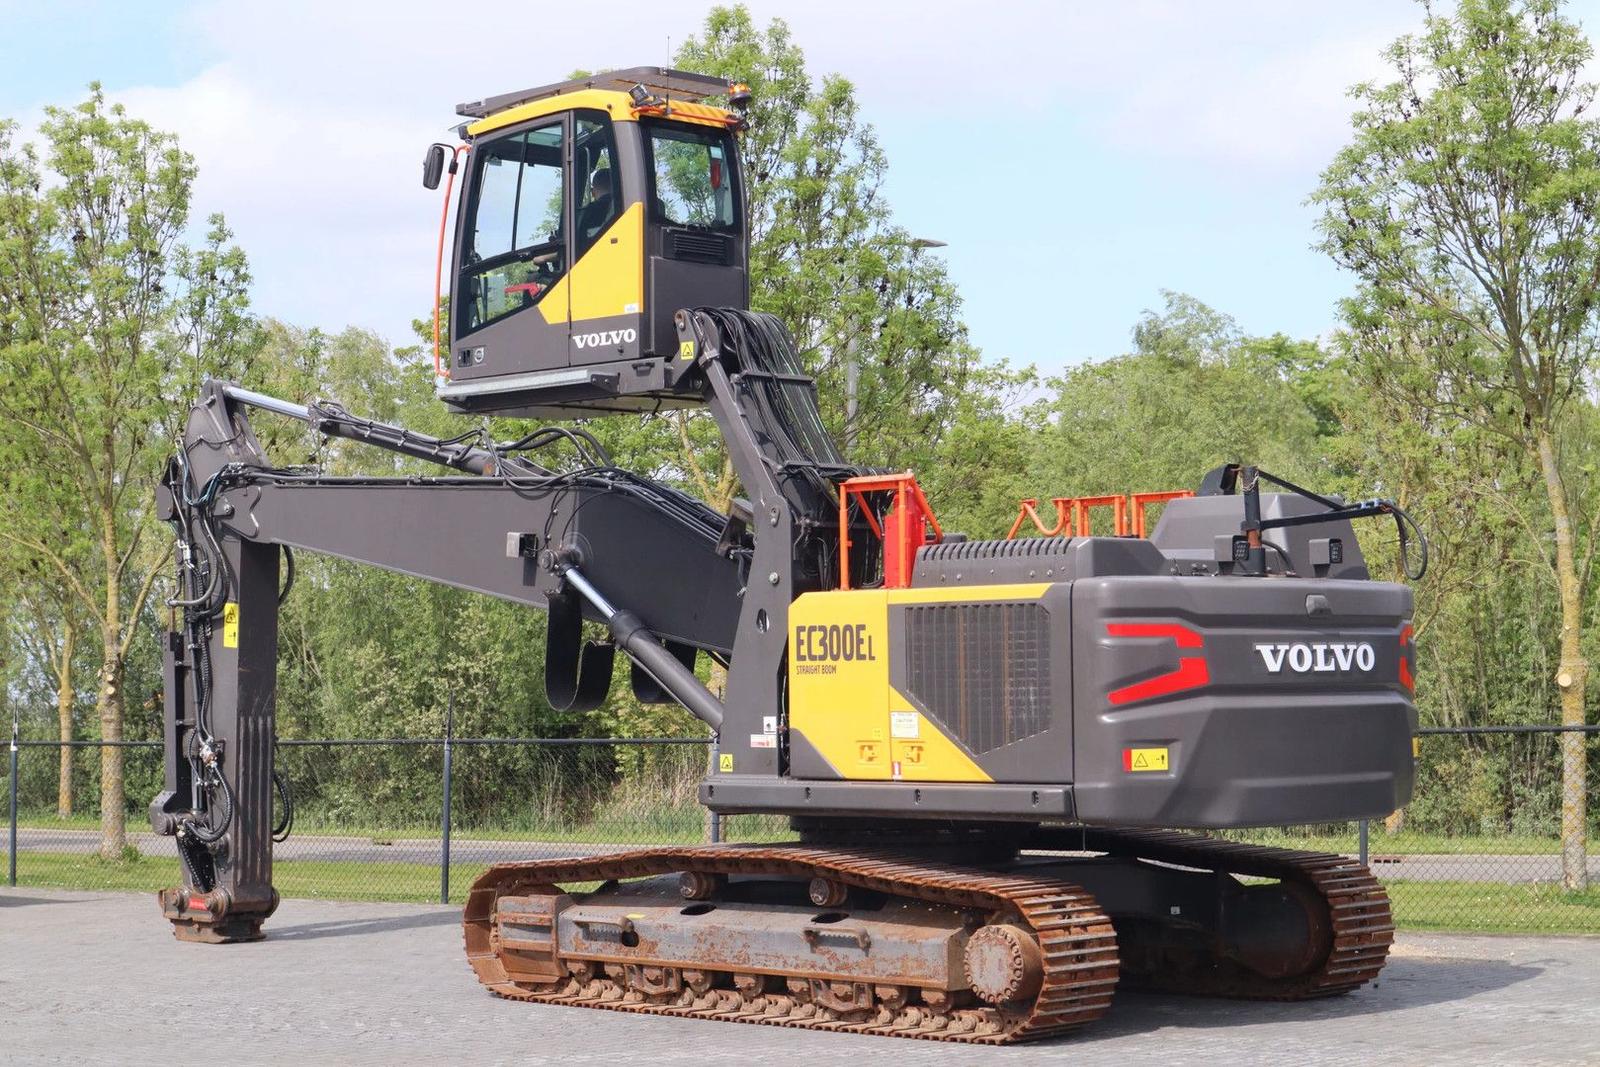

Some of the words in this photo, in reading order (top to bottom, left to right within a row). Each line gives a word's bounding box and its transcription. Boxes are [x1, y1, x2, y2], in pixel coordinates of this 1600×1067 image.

[572, 328, 636, 349] VOLVO
[1255, 643, 1376, 673] VOLVO
[796, 665, 821, 675] STRAIGHT
[821, 664, 837, 674] BOOM
